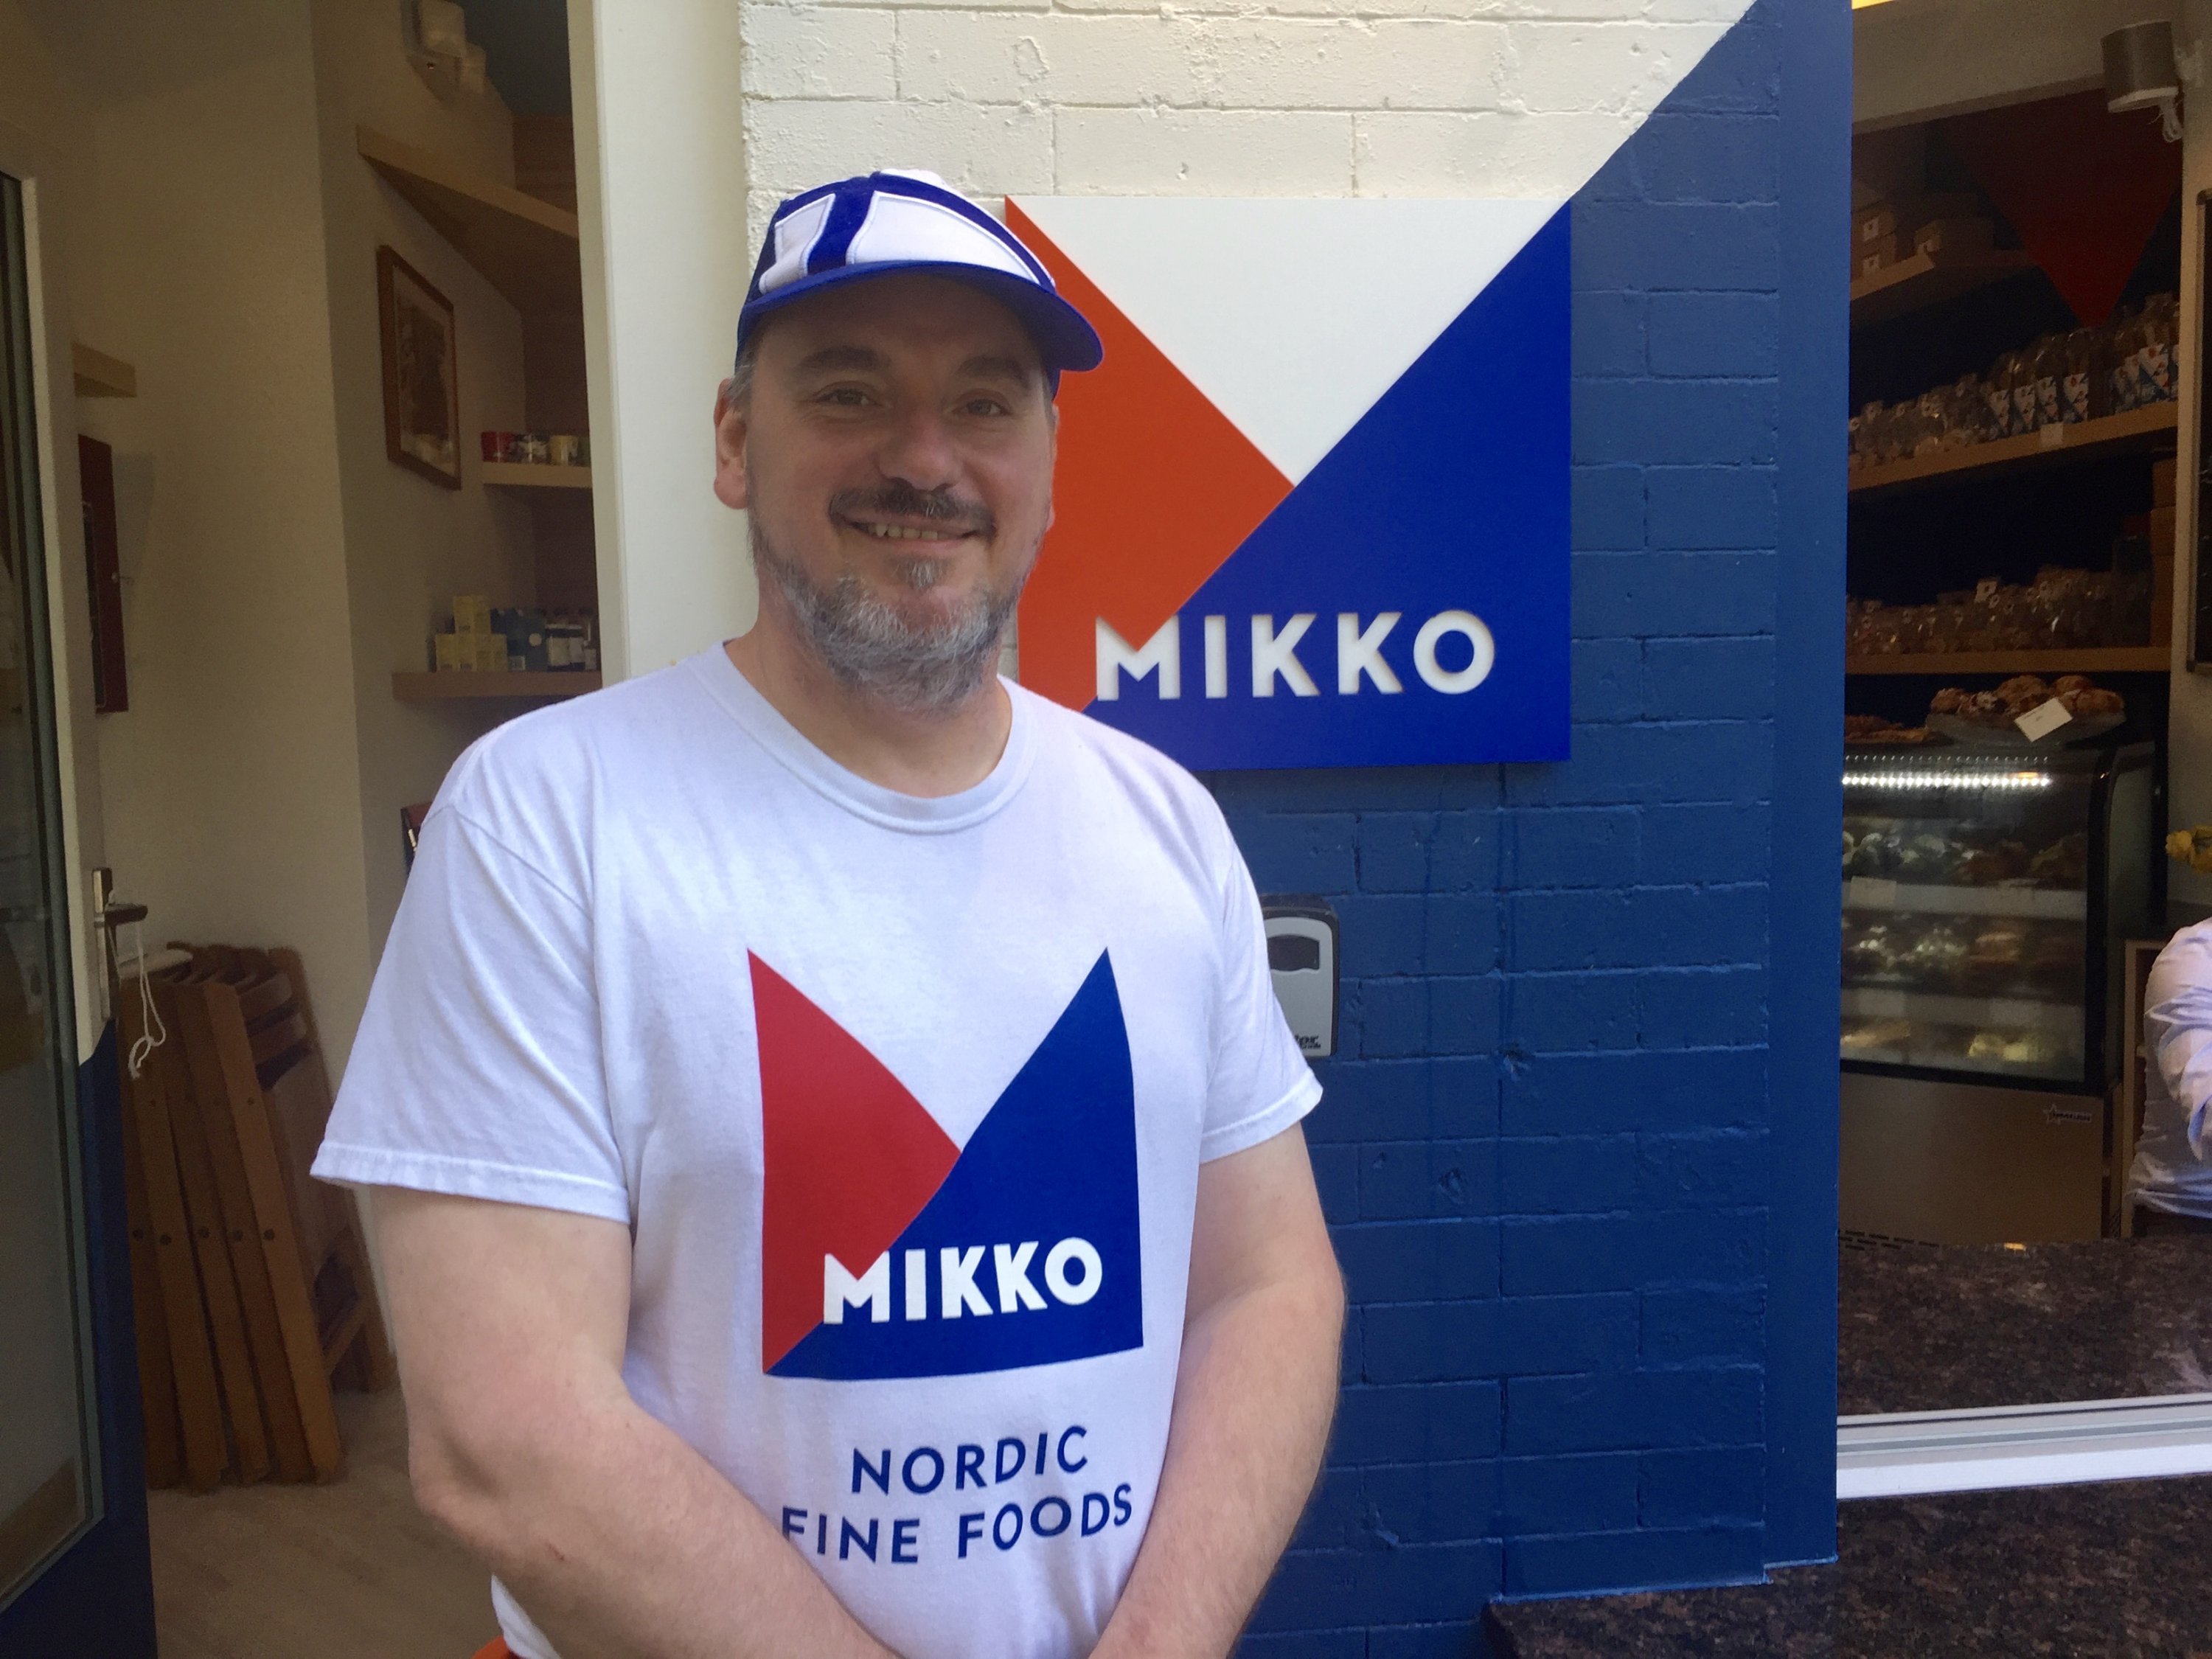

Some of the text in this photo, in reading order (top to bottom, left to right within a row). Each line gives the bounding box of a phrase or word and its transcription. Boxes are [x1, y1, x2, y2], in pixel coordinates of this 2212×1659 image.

[1095, 609, 1496, 701] MIKKO
[823, 1237, 1103, 1324] MIKKO
[851, 1425, 1088, 1495] NORDIC
[782, 1483, 1133, 1564] FINE FOODS
